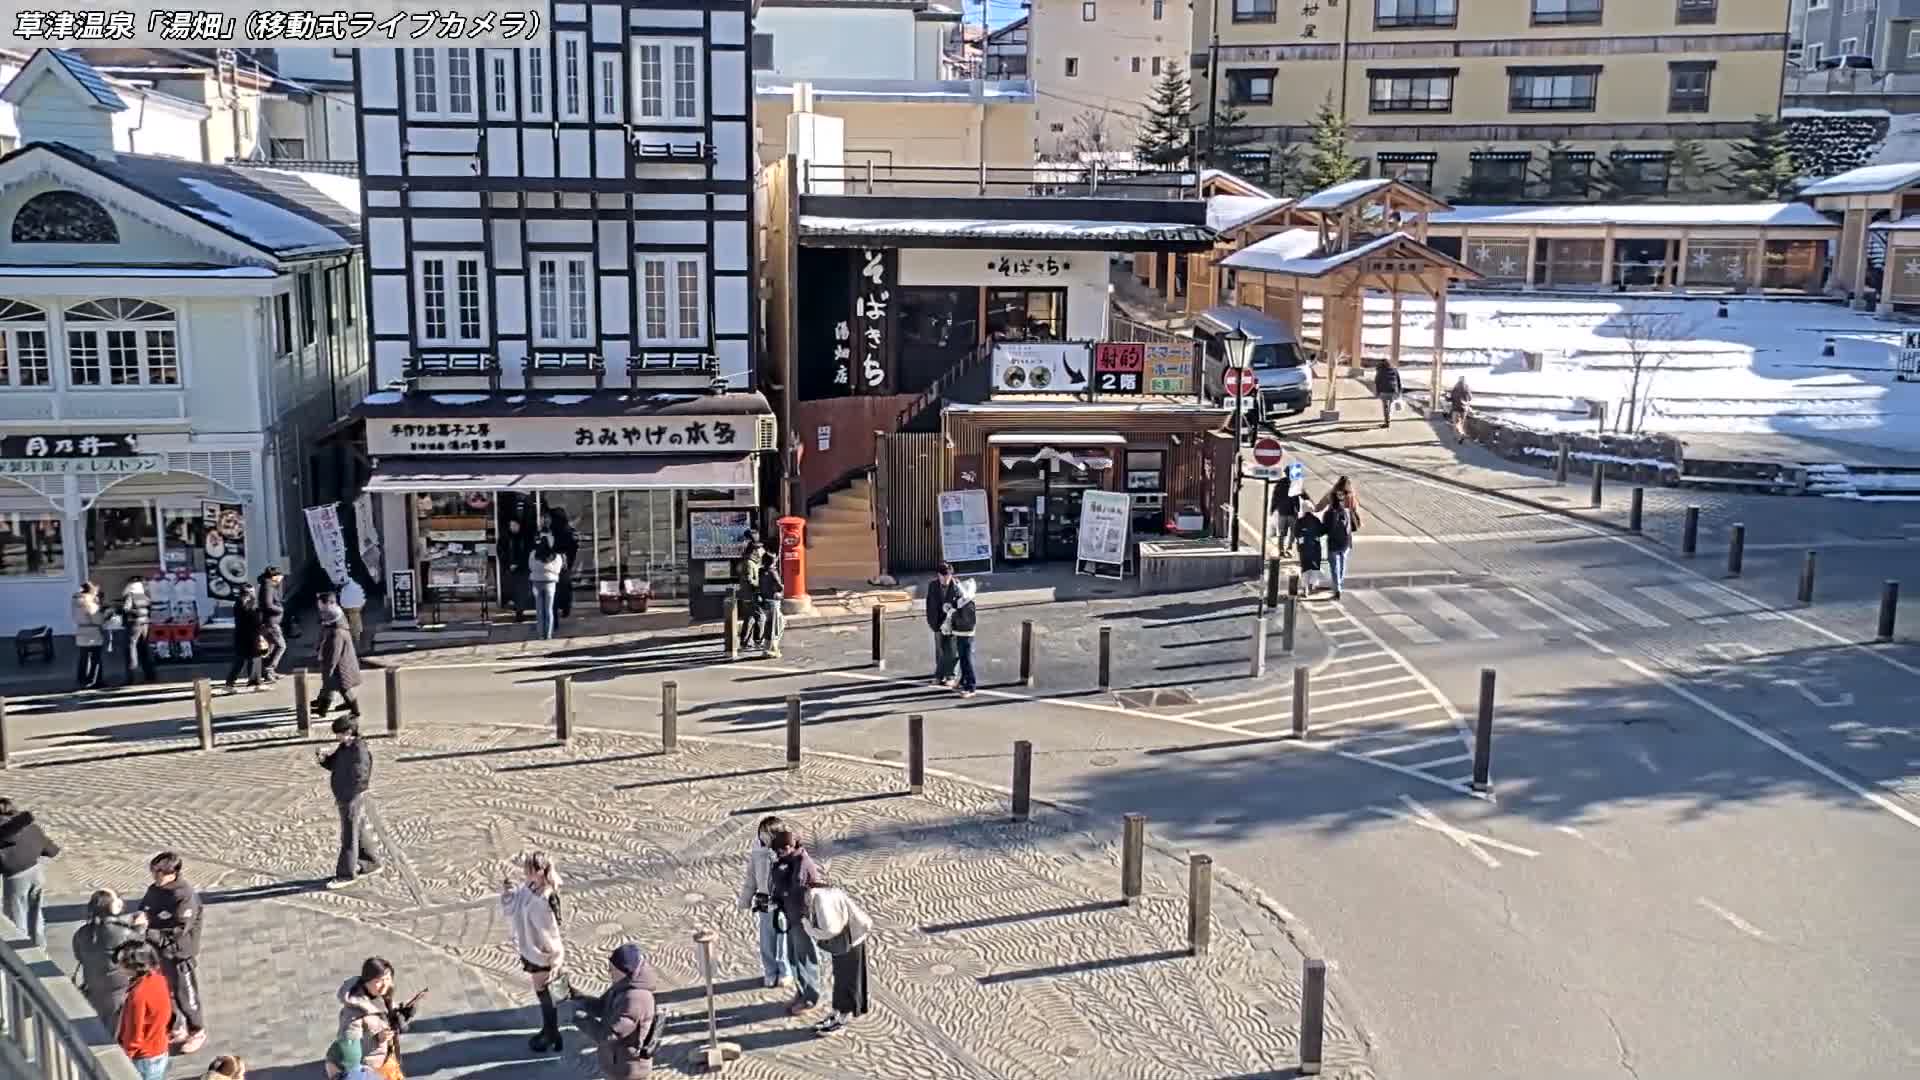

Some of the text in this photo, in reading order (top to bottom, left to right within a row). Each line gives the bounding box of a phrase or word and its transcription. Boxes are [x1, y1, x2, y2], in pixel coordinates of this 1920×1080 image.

[856, 249, 890, 387] そばきち
[833, 320, 850, 384] 湯畑店
[1100, 346, 1140, 369] 射的
[1102, 373, 1137, 390] 2階
[391, 423, 490, 437] 手作りお菓子工房
[575, 421, 737, 446] おみやげの本多
